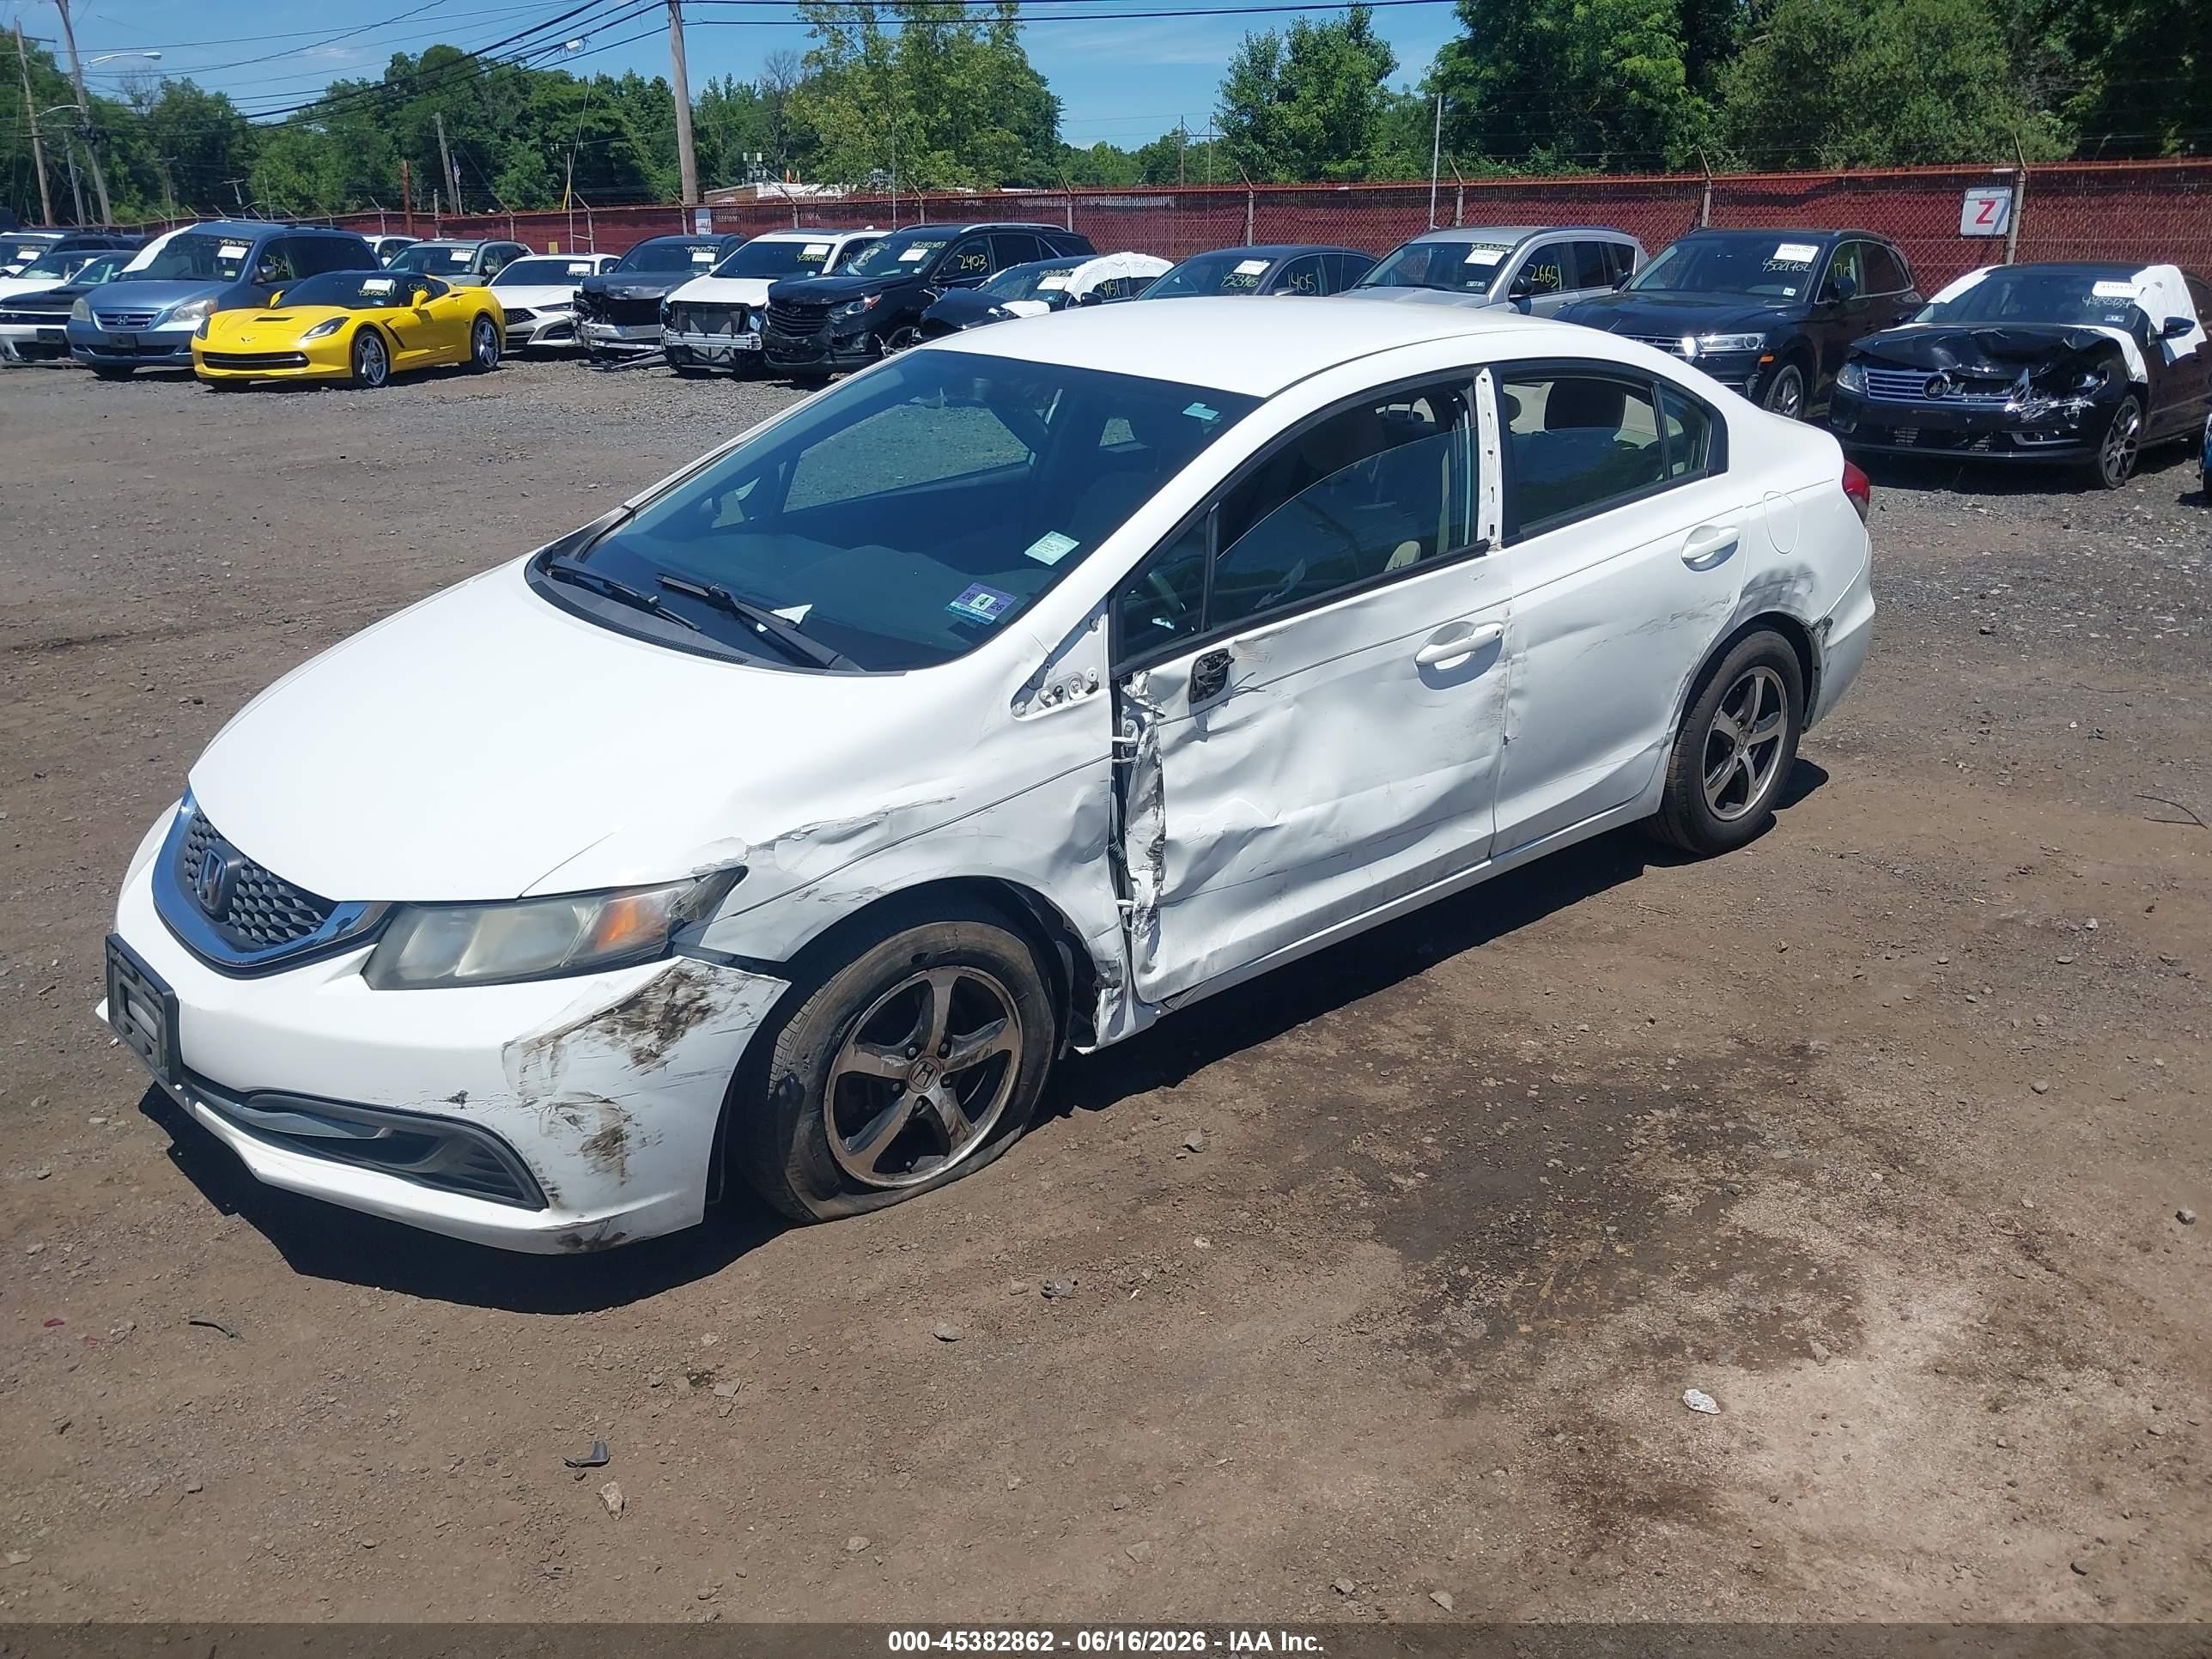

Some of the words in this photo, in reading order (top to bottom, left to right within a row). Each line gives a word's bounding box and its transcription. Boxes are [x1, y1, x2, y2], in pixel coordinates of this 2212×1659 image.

[1975, 200, 1996, 224] Z
[957, 254, 988, 272] 2403
[1288, 272, 1316, 295] 1405
[1528, 264, 1559, 288] 2665
[1100, 280, 1121, 299] 9151
[978, 597, 990, 607] 4
[990, 603, 1004, 611] 26
